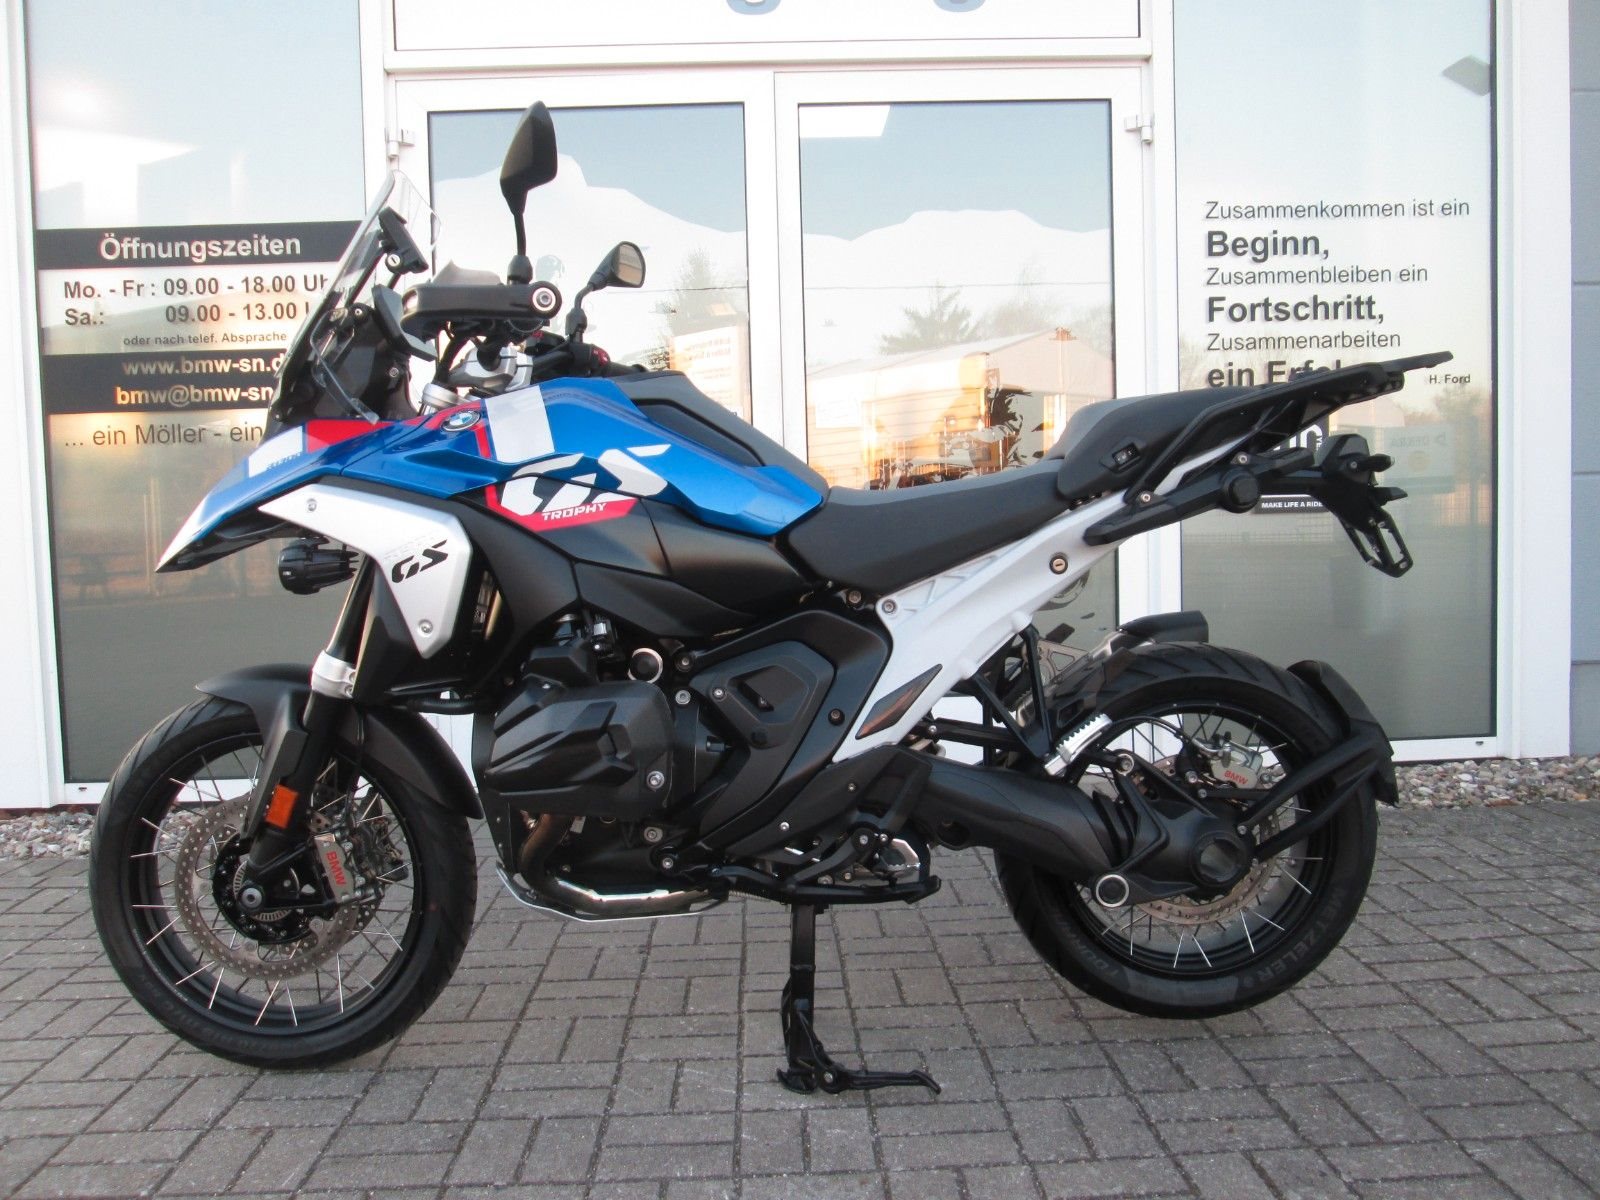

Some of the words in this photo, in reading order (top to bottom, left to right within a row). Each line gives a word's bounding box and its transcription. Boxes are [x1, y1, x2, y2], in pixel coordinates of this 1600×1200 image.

[1205, 200, 1405, 220] Zusammenkommen
[1412, 199, 1434, 216] ist
[1441, 198, 1470, 216] ein
[100, 233, 302, 263] Öffnungszeiten
[1207, 230, 1330, 263] Beginn,
[64, 280, 101, 299] Mo.
[164, 277, 219, 297] 09.00
[241, 275, 295, 294] 18.00
[1206, 266, 1392, 286] Zusammenbleiben
[1399, 264, 1428, 283] ein
[65, 307, 104, 326] Sa.:
[165, 303, 221, 323] 09.00
[243, 302, 297, 320] 13.00
[1208, 294, 1384, 324] Fortschritt,
[123, 334, 151, 346] oder
[155, 333, 184, 345] nach
[186, 332, 218, 344] telef.
[221, 331, 287, 346] Absprache
[1207, 331, 1401, 352] Zusammenarbeiten
[1208, 361, 1255, 388] ein
[1429, 375, 1441, 384] H.
[1444, 374, 1471, 384] Ford
[93, 425, 126, 447] ein
[135, 420, 207, 446] Möller
[229, 420, 263, 442] ein
[541, 502, 608, 521] TROPHY
[1261, 501, 1283, 509] MAKE
[391, 539, 448, 583] GS
[1224, 769, 1248, 785] BMW
[326, 851, 346, 885] BMW
